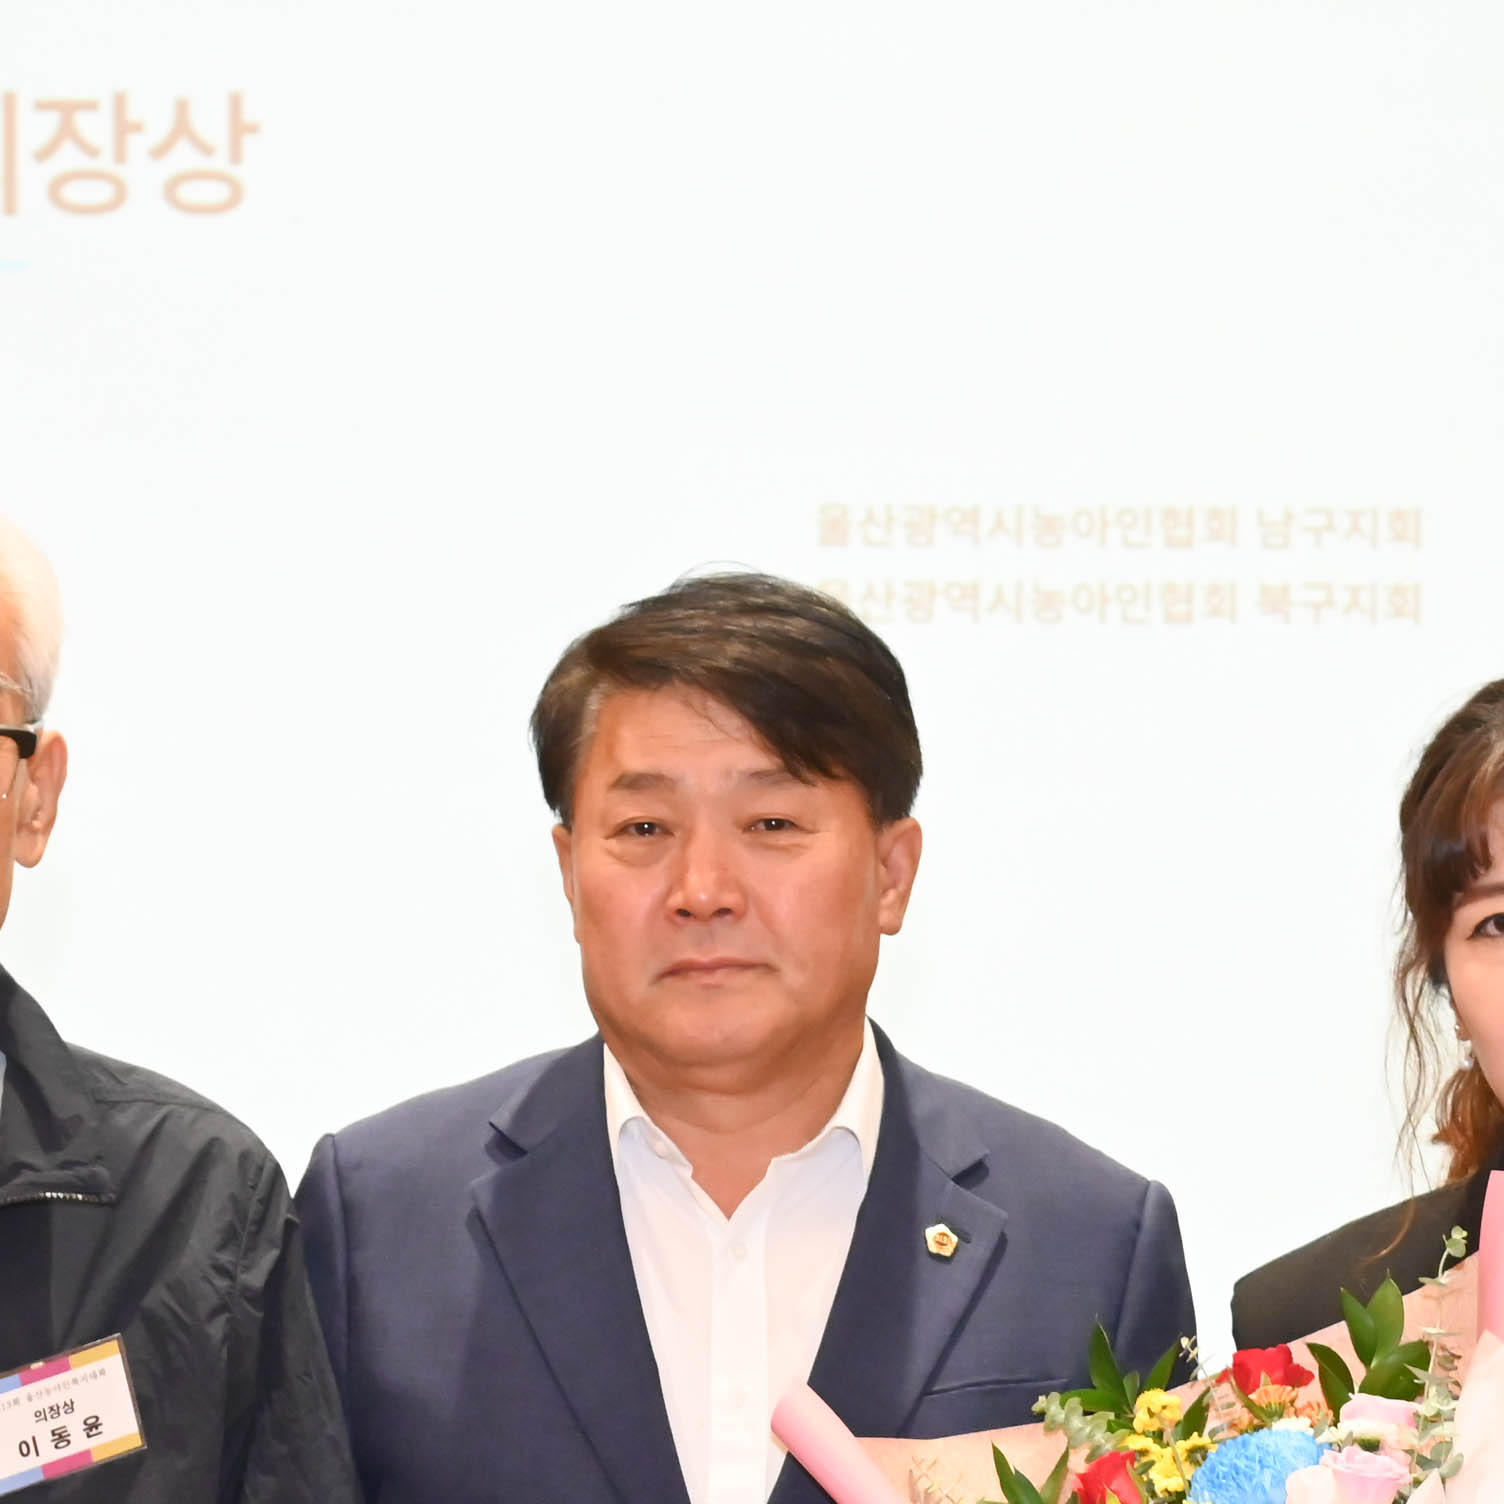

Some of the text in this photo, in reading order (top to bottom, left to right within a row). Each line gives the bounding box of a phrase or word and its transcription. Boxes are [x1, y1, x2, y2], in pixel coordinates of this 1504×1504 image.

[818, 504, 1239, 550] 울산광역시농아인협회
[1257, 505, 1424, 550] 남구지회
[1258, 581, 1423, 626] 북구지회
[34, 1398, 75, 1423] 의장상
